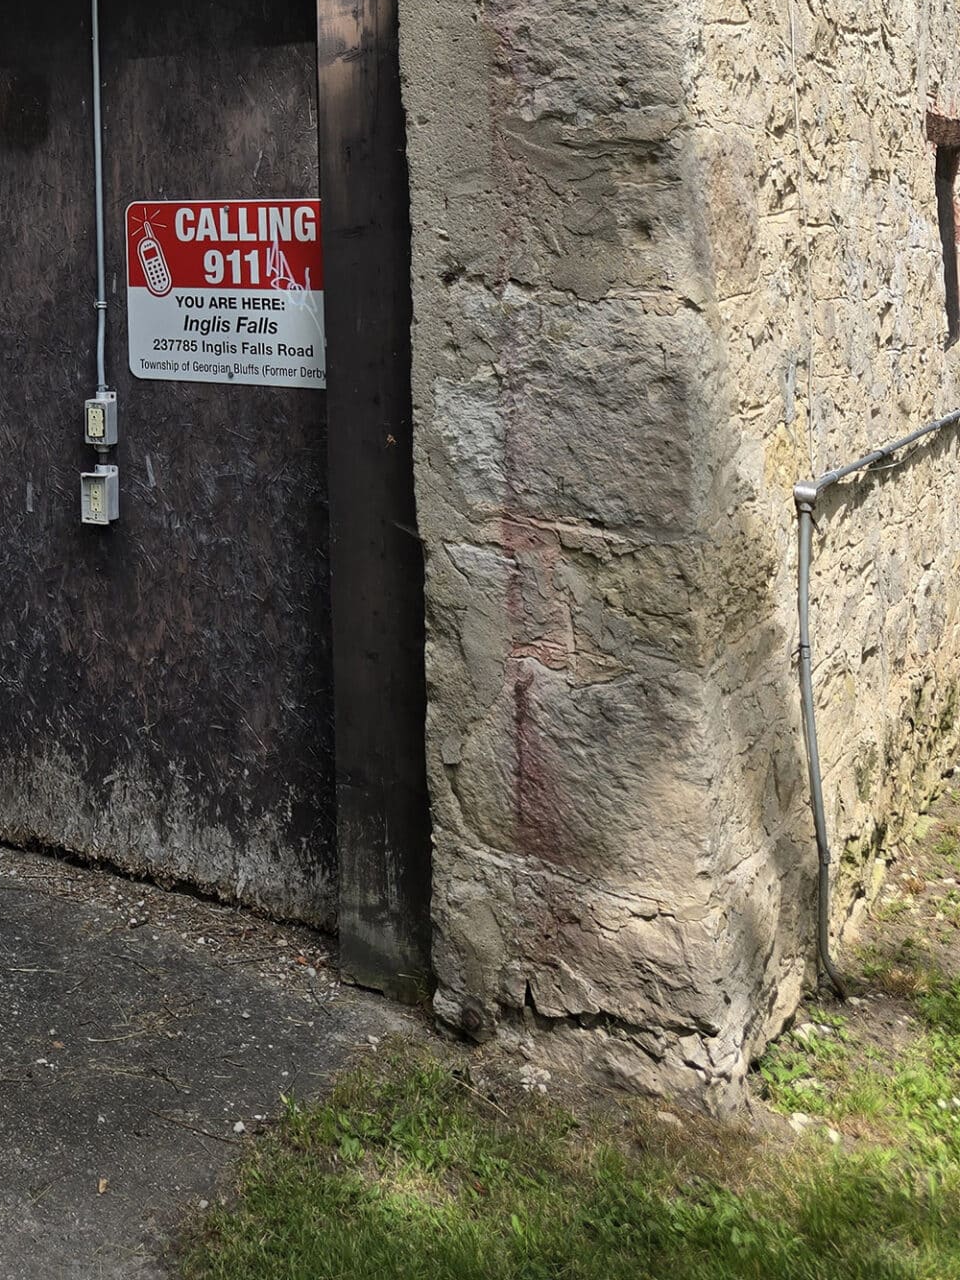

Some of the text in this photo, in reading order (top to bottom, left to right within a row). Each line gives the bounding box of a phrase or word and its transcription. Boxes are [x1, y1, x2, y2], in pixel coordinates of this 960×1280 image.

[175, 206, 317, 242] CALLING
[203, 249, 260, 285] 911
[175, 296, 286, 311] YOU ARE HERE:
[183, 315, 278, 336] Inglis Falls
[153, 338, 314, 357] 237785 Inglis Falls Road
[140, 358, 179, 373] Township
[182, 360, 190, 371] of
[192, 362, 230, 375] Georgian
[234, 363, 260, 375] Bluffs
[262, 365, 297, 378] (Former
